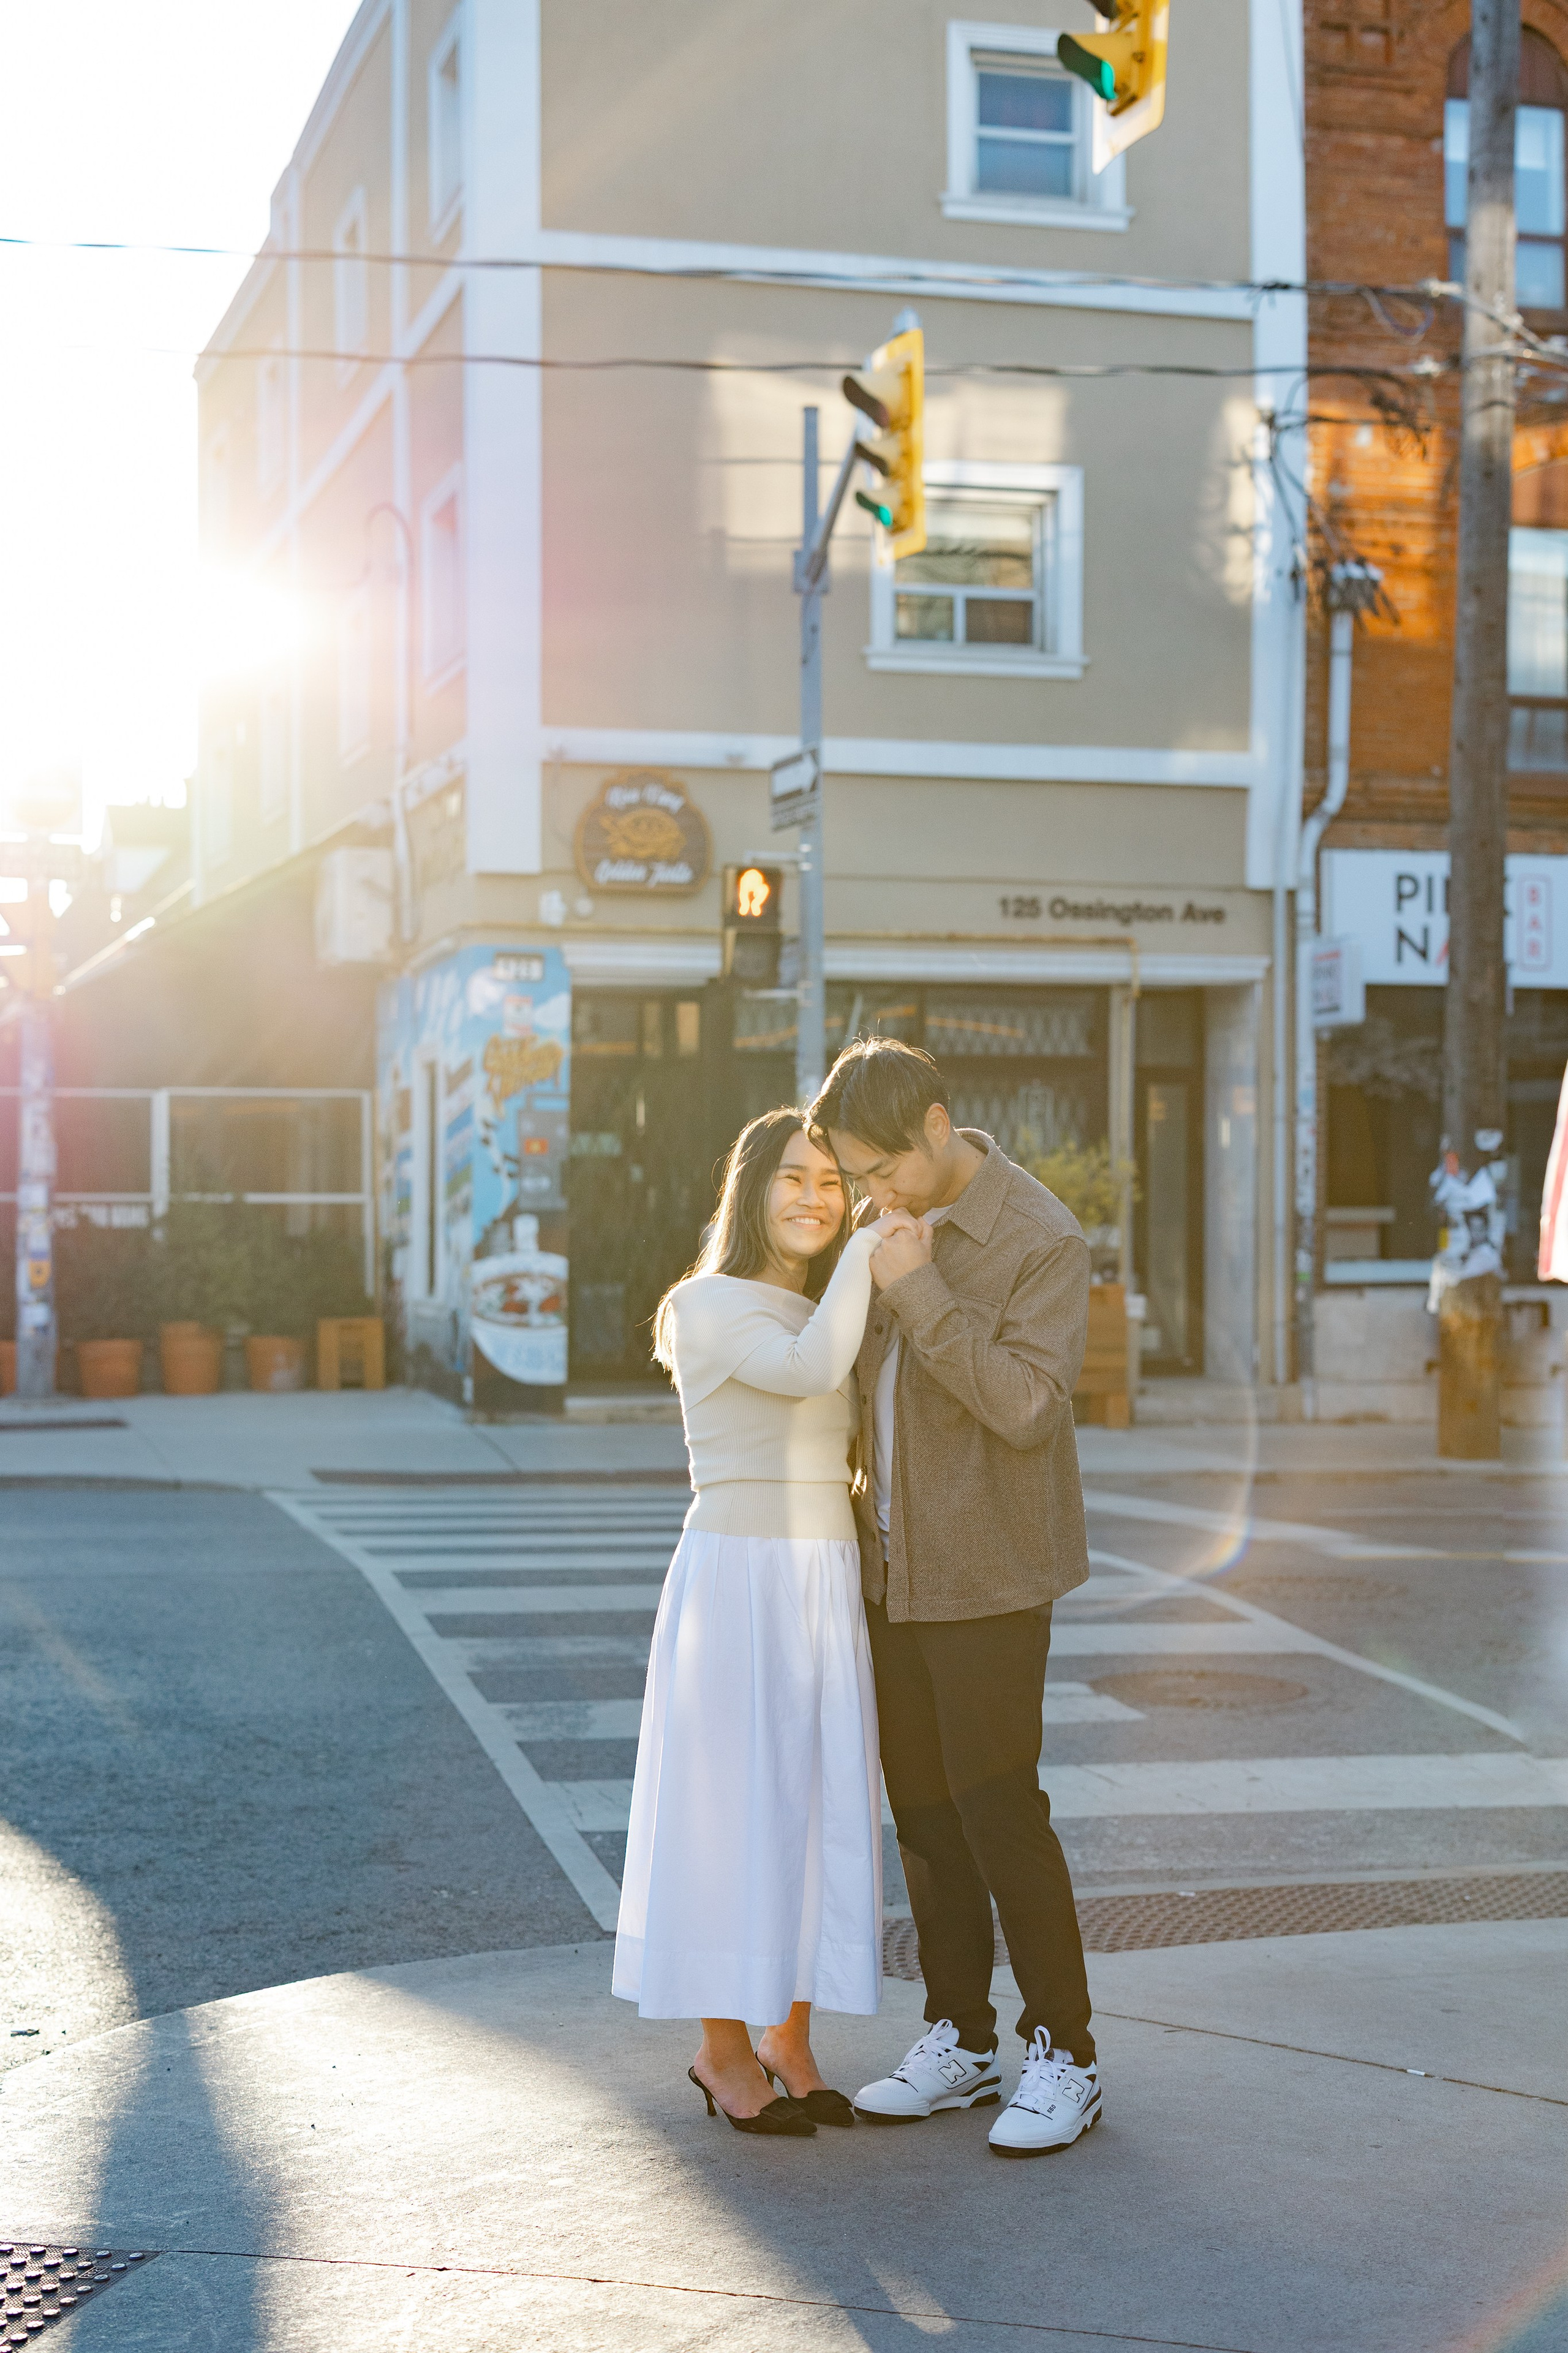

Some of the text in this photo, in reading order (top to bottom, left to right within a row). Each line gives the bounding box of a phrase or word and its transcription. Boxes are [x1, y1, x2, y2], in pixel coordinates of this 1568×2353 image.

[1000, 897, 1226, 926] 125 Ossington Ave
[1047, 2104, 1056, 2114] 550
